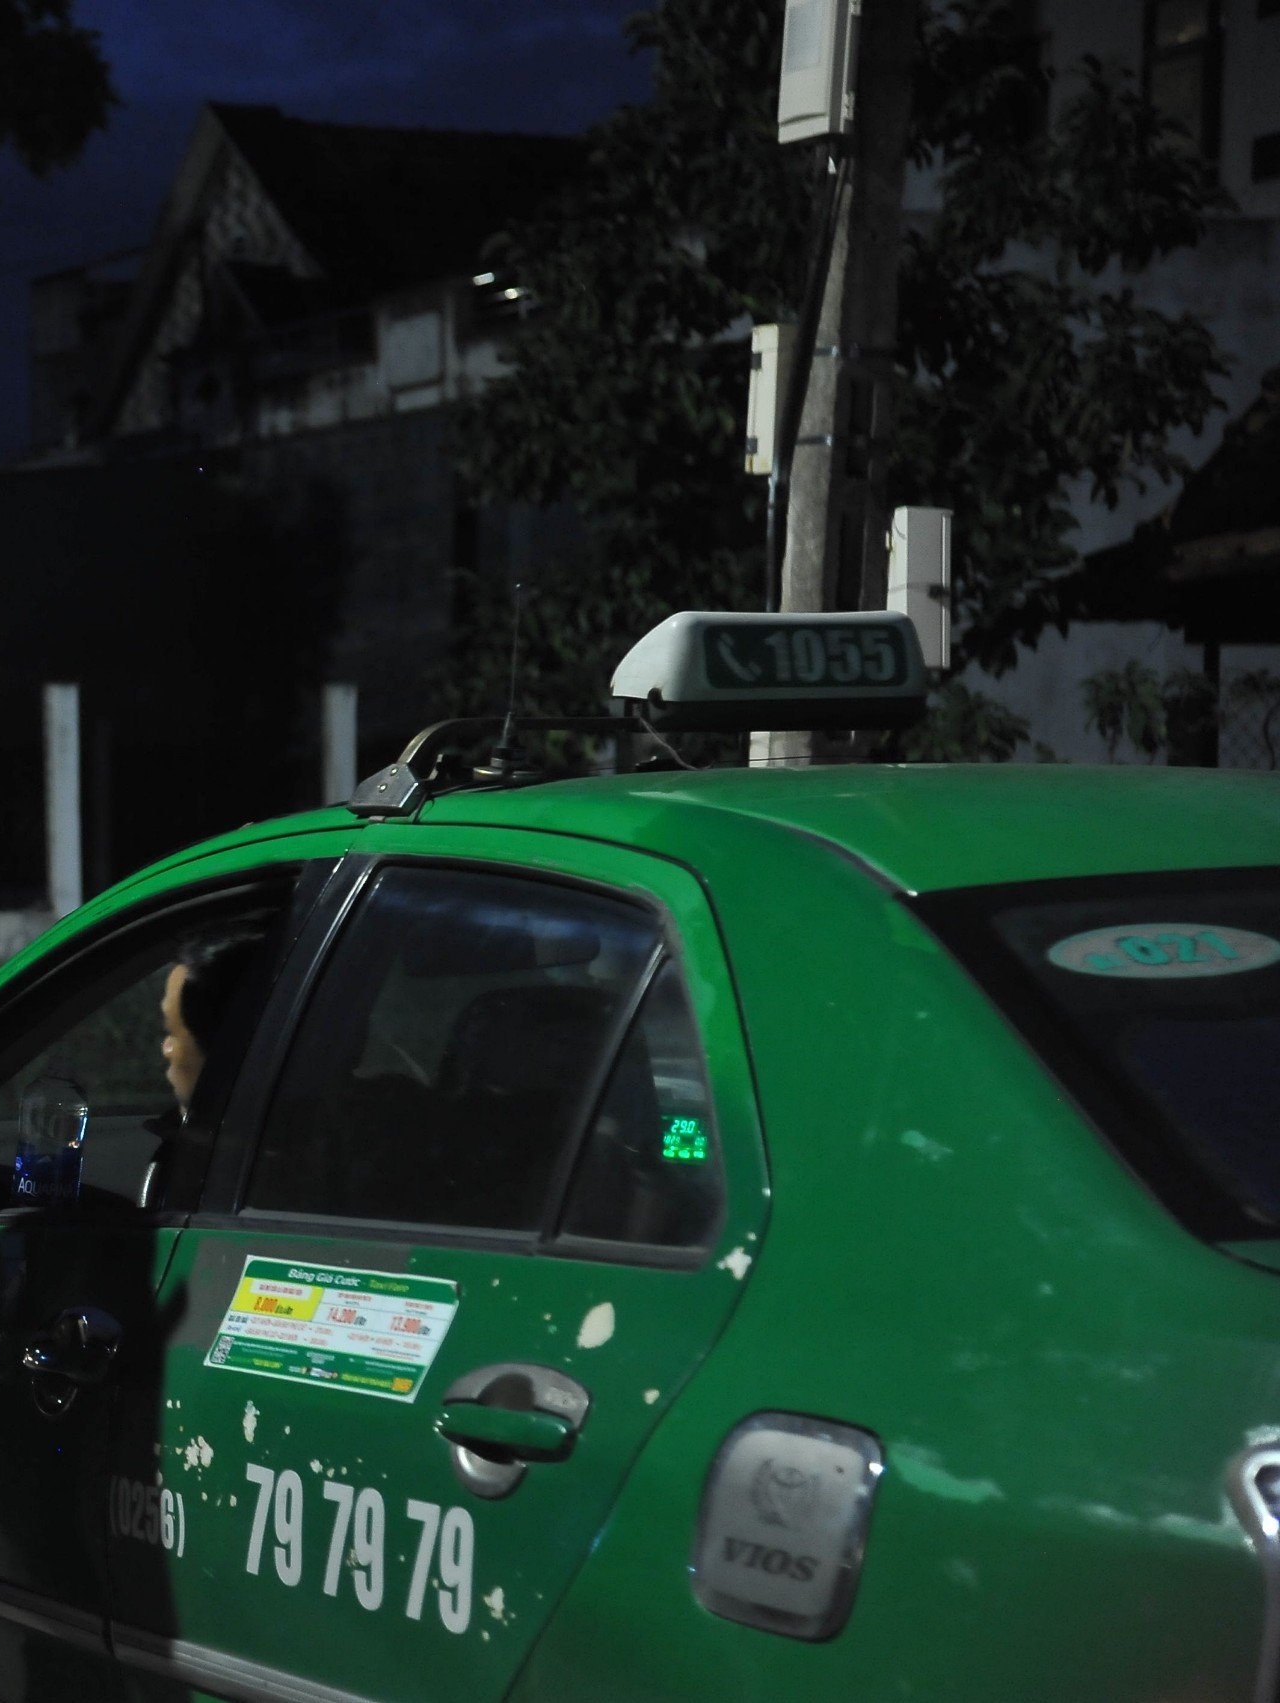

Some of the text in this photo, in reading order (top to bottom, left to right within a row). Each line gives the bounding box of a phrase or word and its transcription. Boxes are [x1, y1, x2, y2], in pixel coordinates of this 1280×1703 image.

[765, 628, 896, 682] 1055
[109, 1462, 474, 1634] (0256) 79 79 79
[724, 1536, 819, 1582] VIOS
